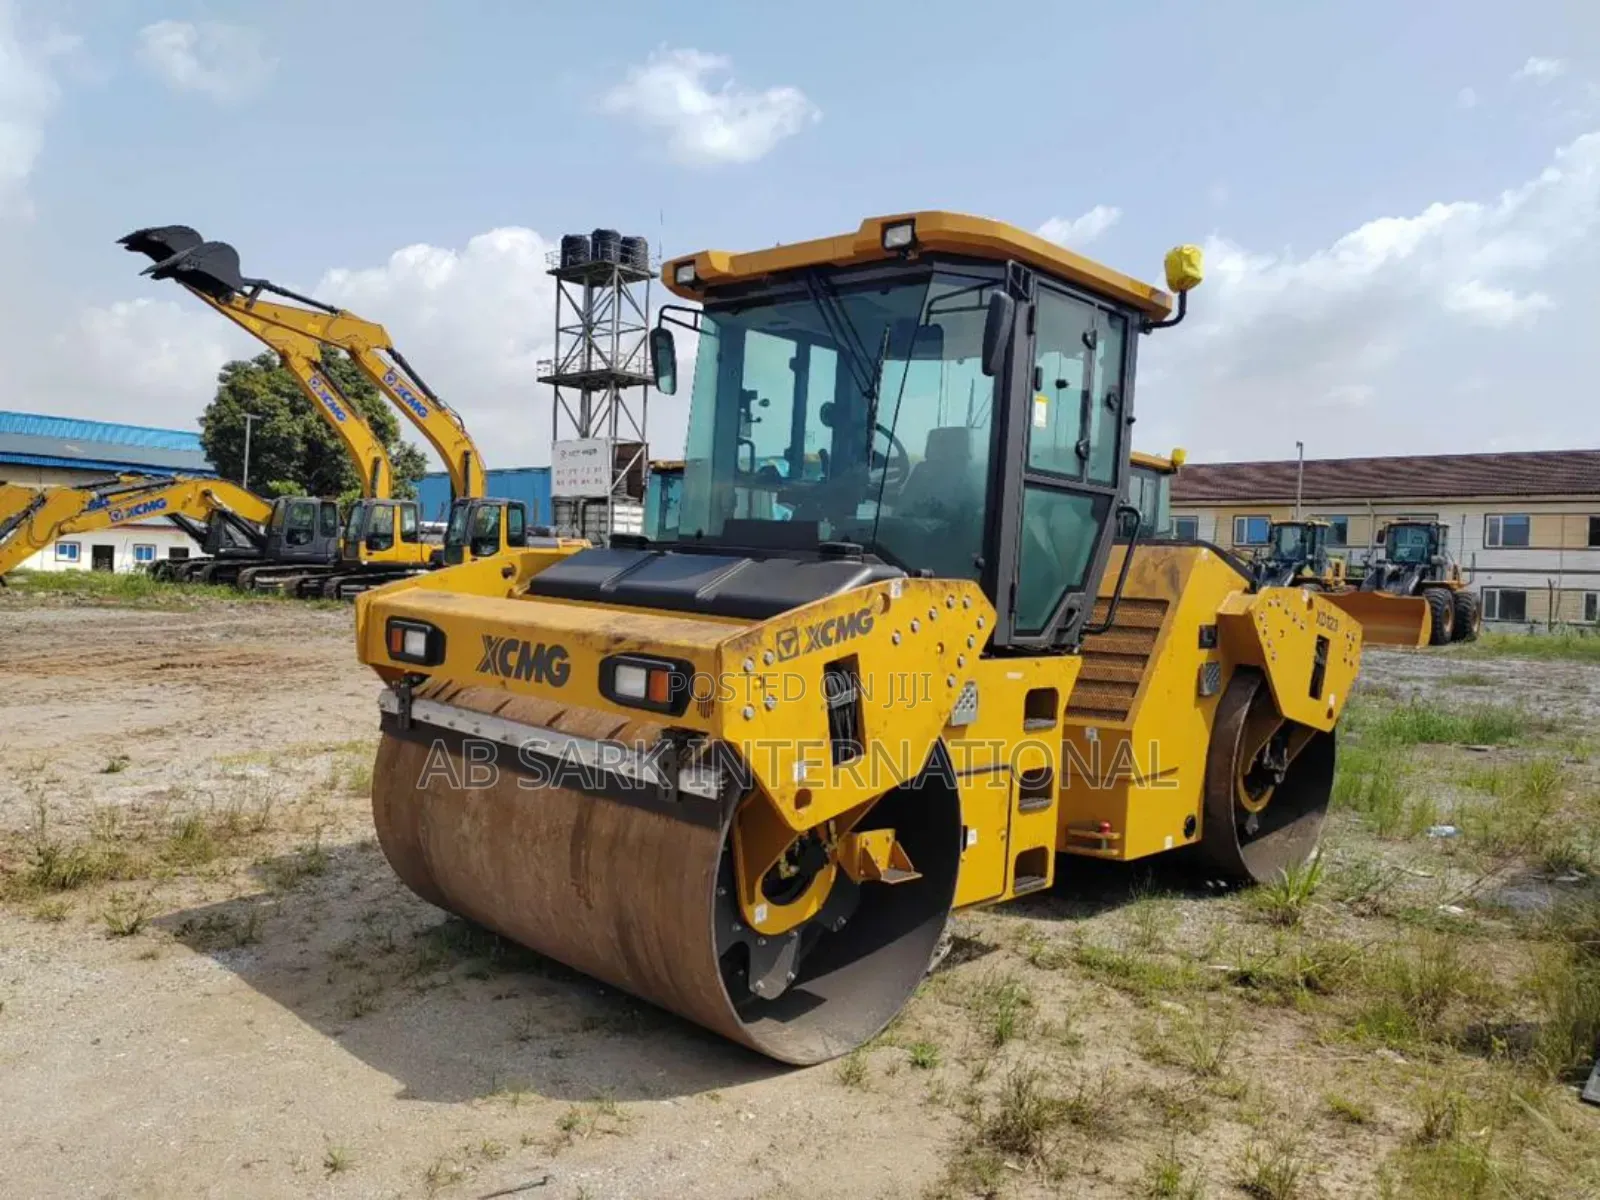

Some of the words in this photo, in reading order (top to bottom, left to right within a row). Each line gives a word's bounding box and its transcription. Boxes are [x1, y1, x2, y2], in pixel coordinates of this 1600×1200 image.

[318, 389, 346, 421] XCMG
[395, 386, 428, 418] XCMG
[126, 498, 167, 516] XCMG
[800, 608, 875, 654] XCMG
[475, 634, 571, 688] XCMG
